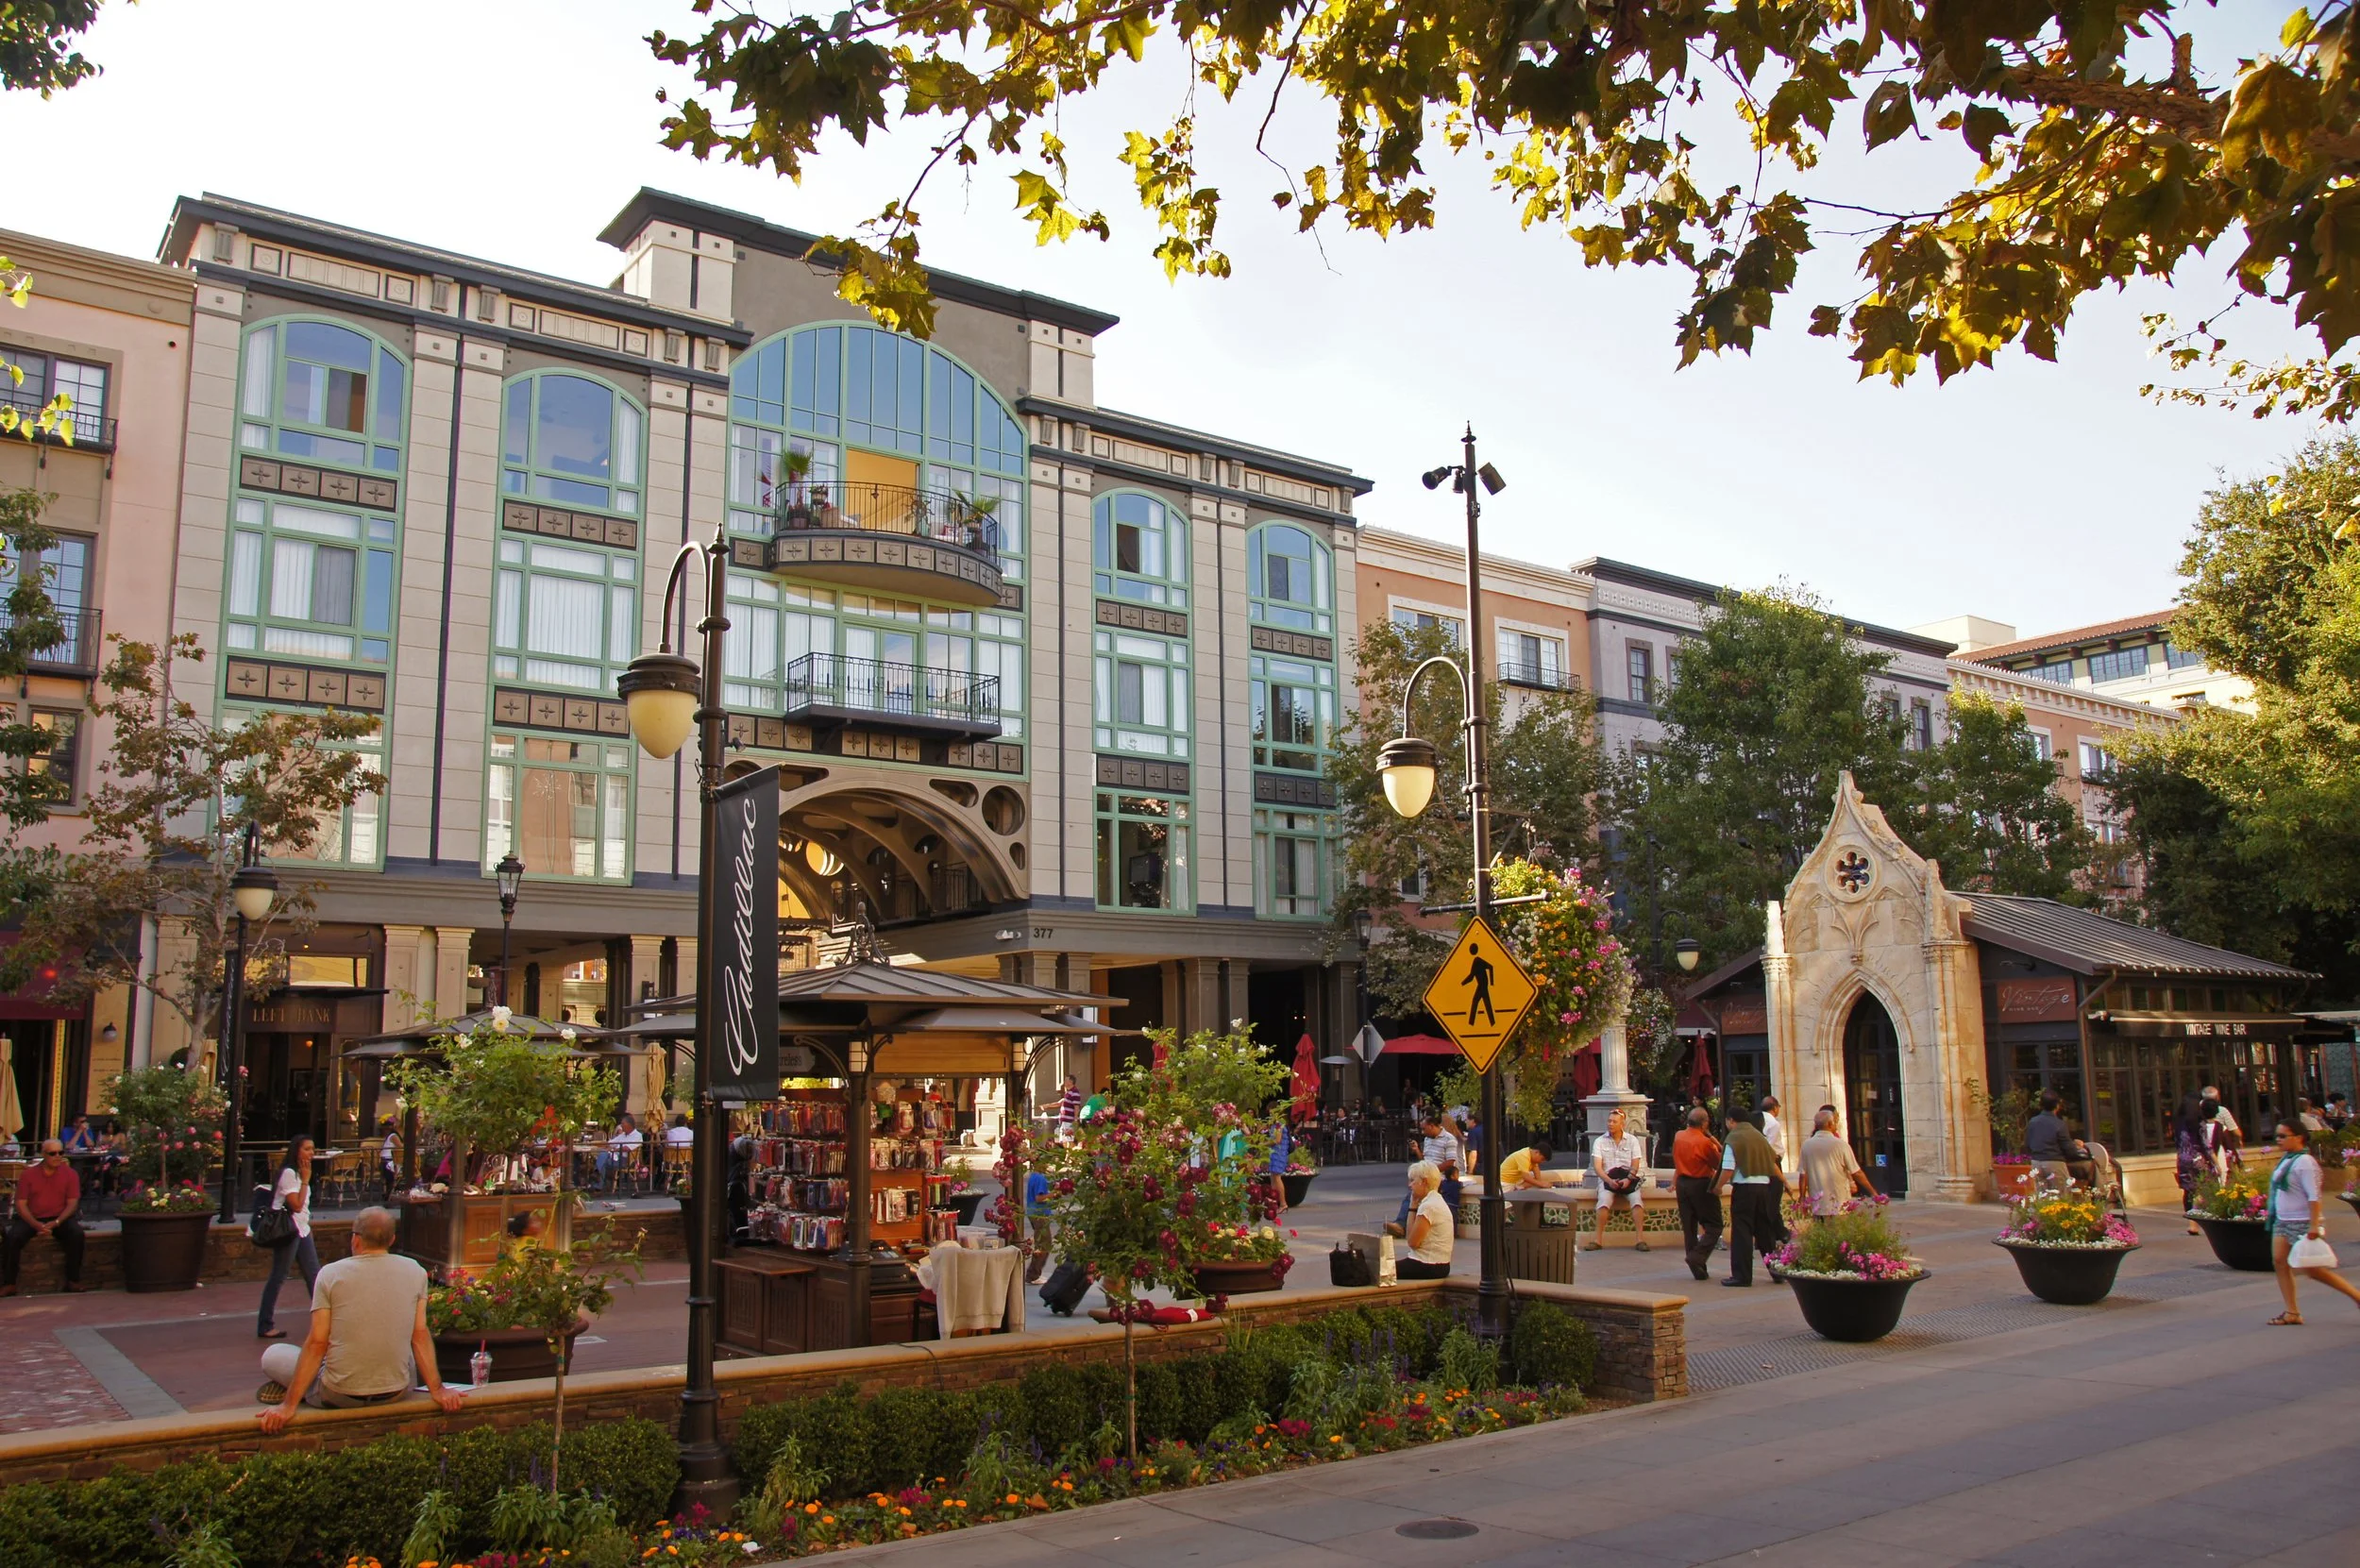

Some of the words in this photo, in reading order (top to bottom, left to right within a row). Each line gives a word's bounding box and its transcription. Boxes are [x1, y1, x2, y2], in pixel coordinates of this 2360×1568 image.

[725, 798, 758, 1076] Cadillac
[1034, 928, 1054, 938] 377
[252, 1007, 285, 1022] LEFT
[296, 1007, 330, 1022] BANK
[2185, 1023, 2212, 1036] VINTAGE
[2215, 1023, 2231, 1036] WINE
[2233, 1023, 2247, 1036] BAR
[780, 1054, 802, 1067] reless
